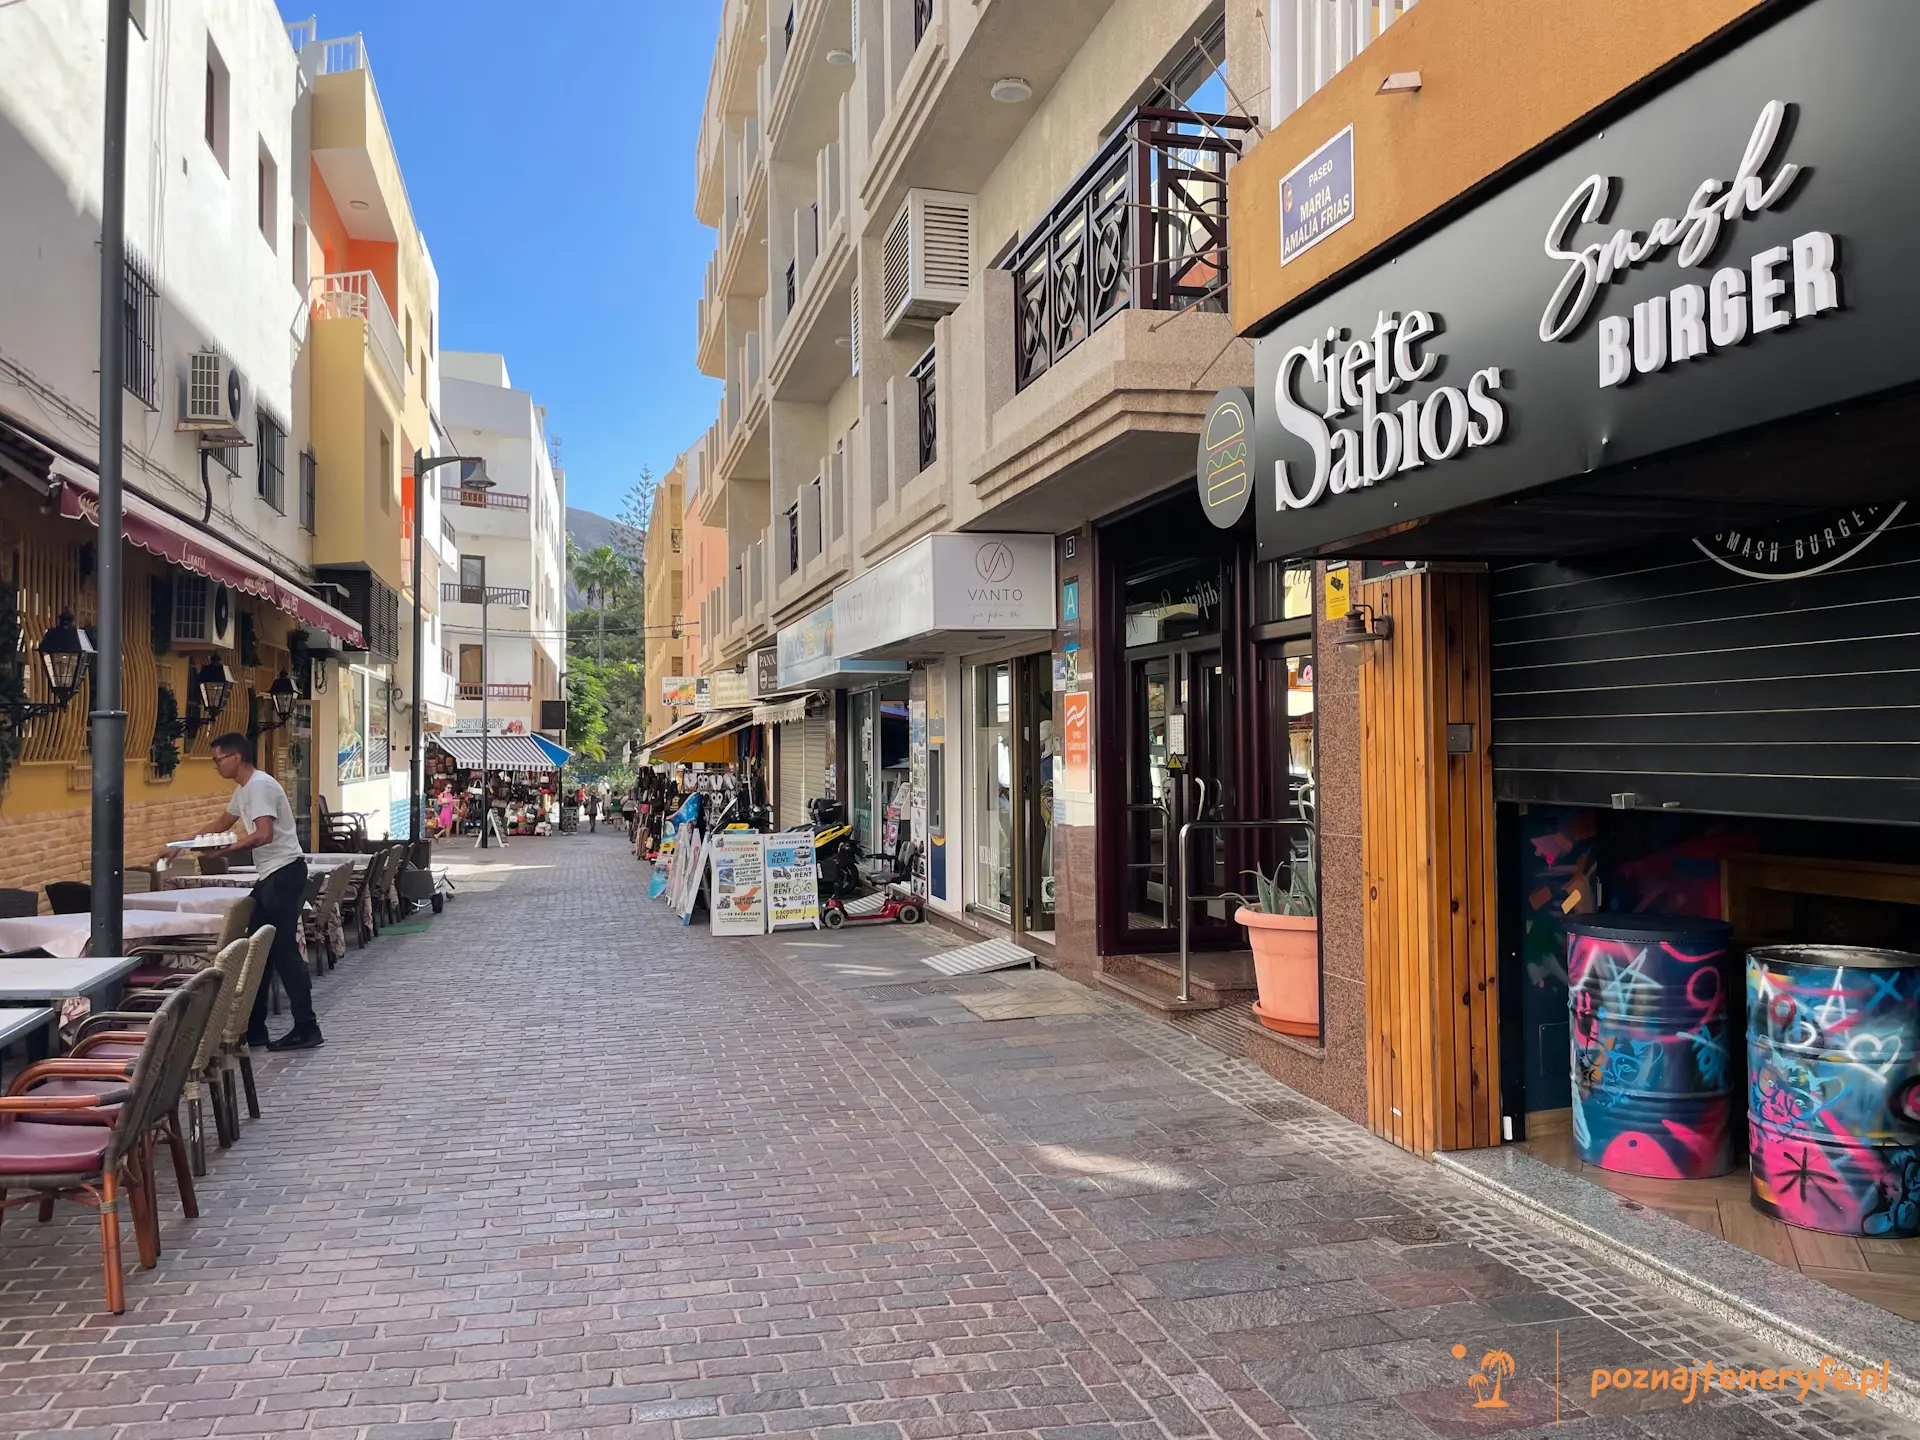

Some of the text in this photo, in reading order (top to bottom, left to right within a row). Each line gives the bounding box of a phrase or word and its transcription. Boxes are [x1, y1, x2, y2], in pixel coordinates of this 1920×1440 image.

[1308, 160, 1333, 187] PASEO
[1284, 194, 1350, 255] AMALIA FRIAS
[1300, 185, 1332, 223] MARIA
[1539, 100, 1798, 342] Smash
[1599, 231, 1838, 388] BURGER
[1275, 310, 1438, 470] Siete
[1275, 340, 1503, 511] Sabios
[1795, 506, 1879, 560] BURGE
[968, 589, 1023, 601] VANTO
[1067, 588, 1075, 616] A
